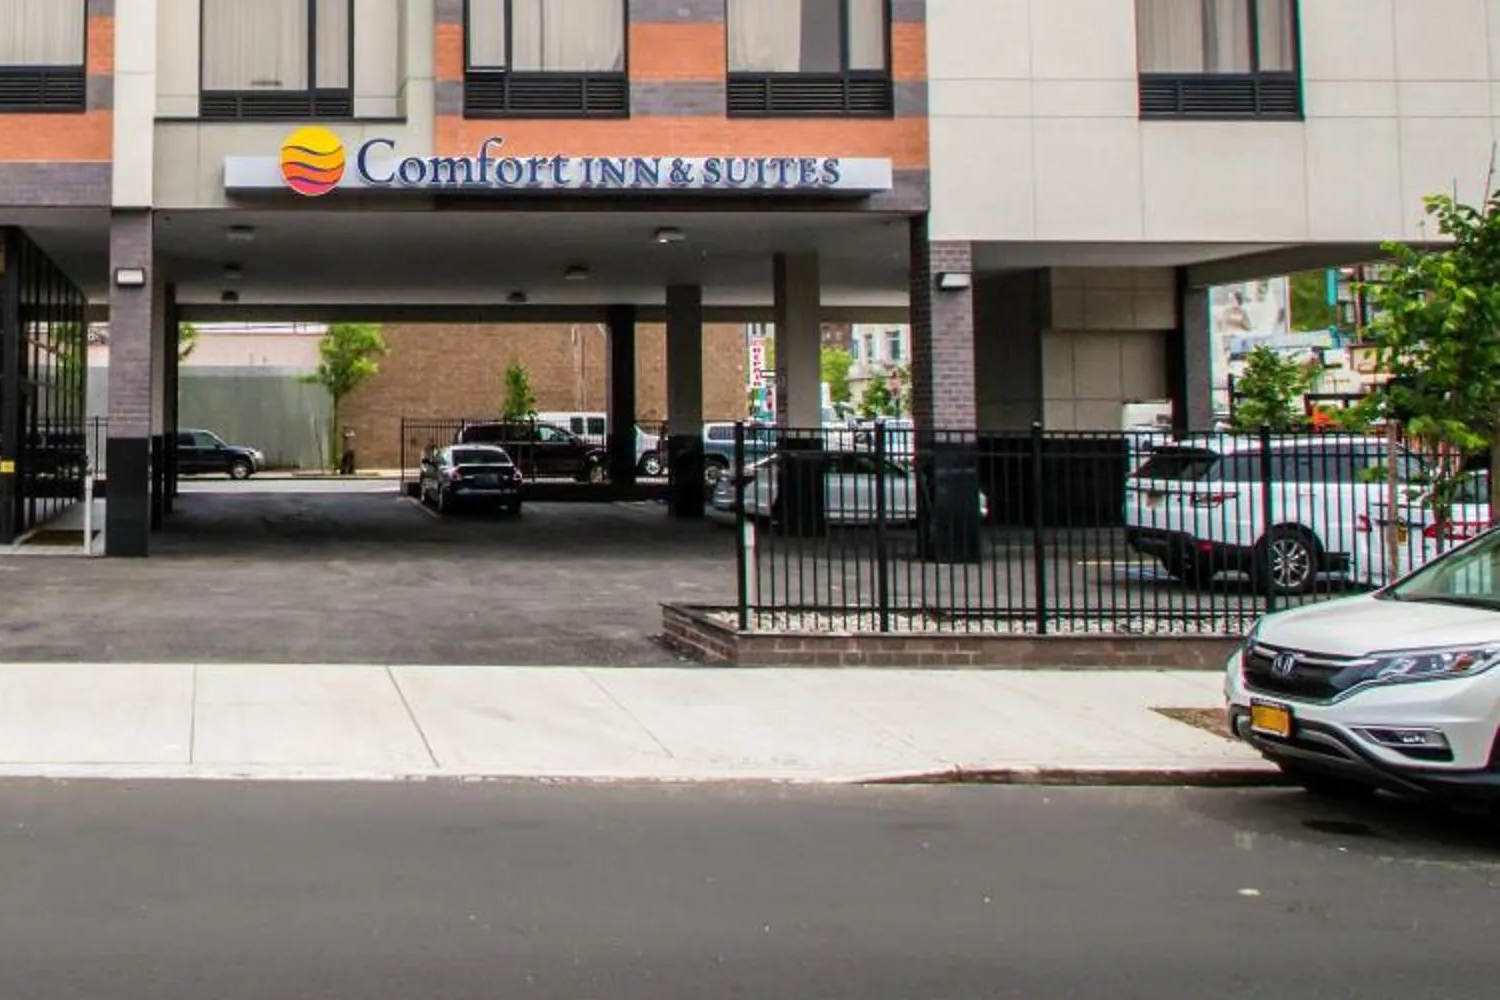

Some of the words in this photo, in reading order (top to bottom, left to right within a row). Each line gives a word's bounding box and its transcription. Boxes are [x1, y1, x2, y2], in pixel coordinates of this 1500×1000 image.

[357, 137, 572, 187] Comfort
[581, 157, 661, 186] INN
[669, 157, 695, 186] &
[703, 157, 841, 186] SUITES
